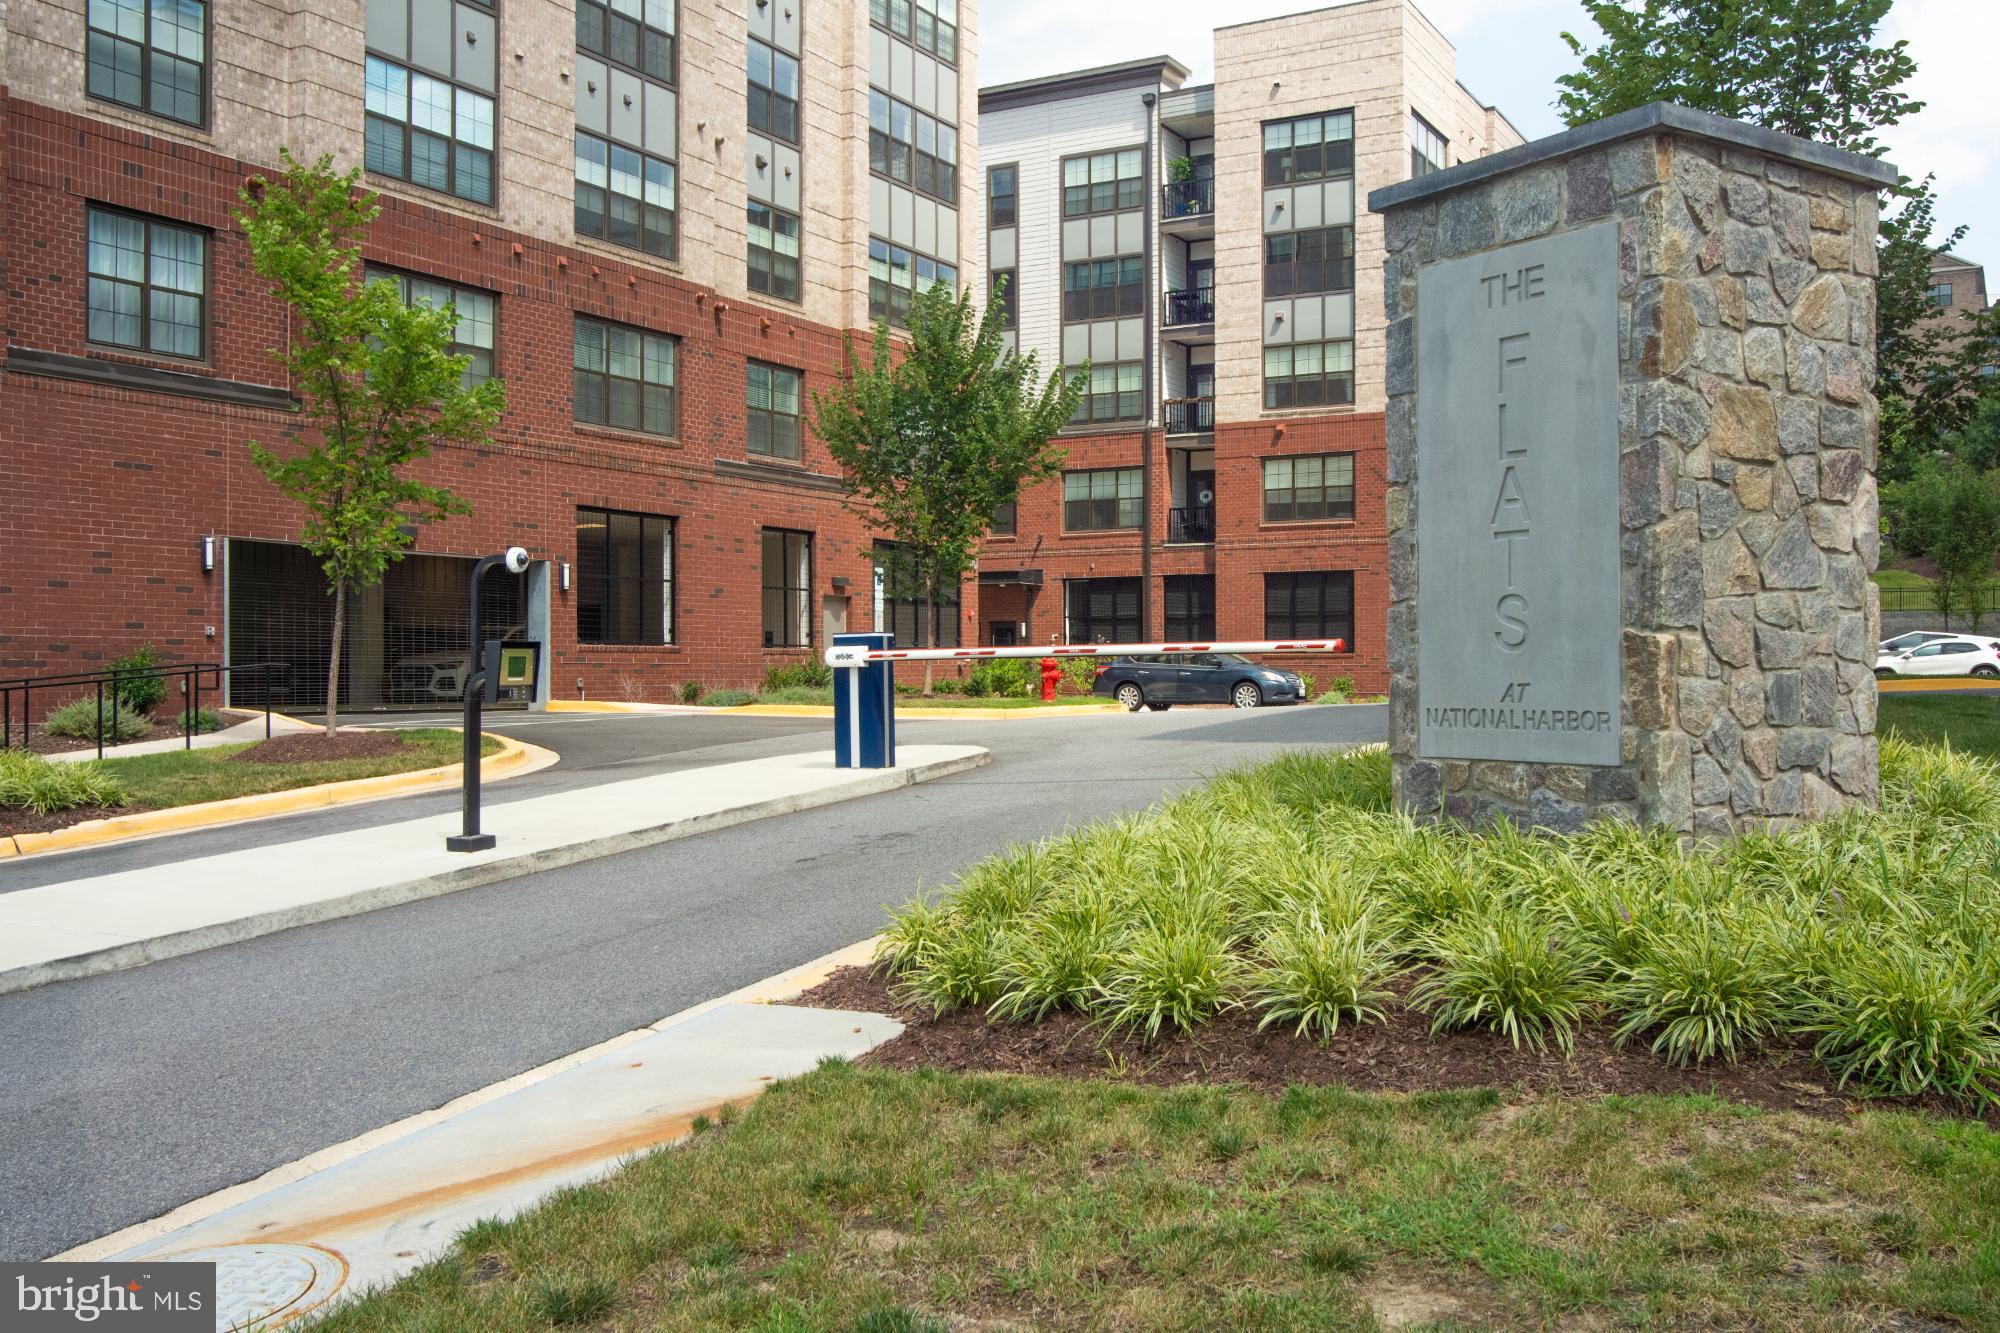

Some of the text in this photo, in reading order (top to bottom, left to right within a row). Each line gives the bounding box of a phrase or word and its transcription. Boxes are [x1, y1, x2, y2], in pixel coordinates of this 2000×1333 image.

[1480, 263, 1545, 310] THE
[1490, 332, 1532, 653] FLATS
[1500, 682, 1531, 704] AT
[1425, 707, 1612, 733] NATIONAL HARBOR
